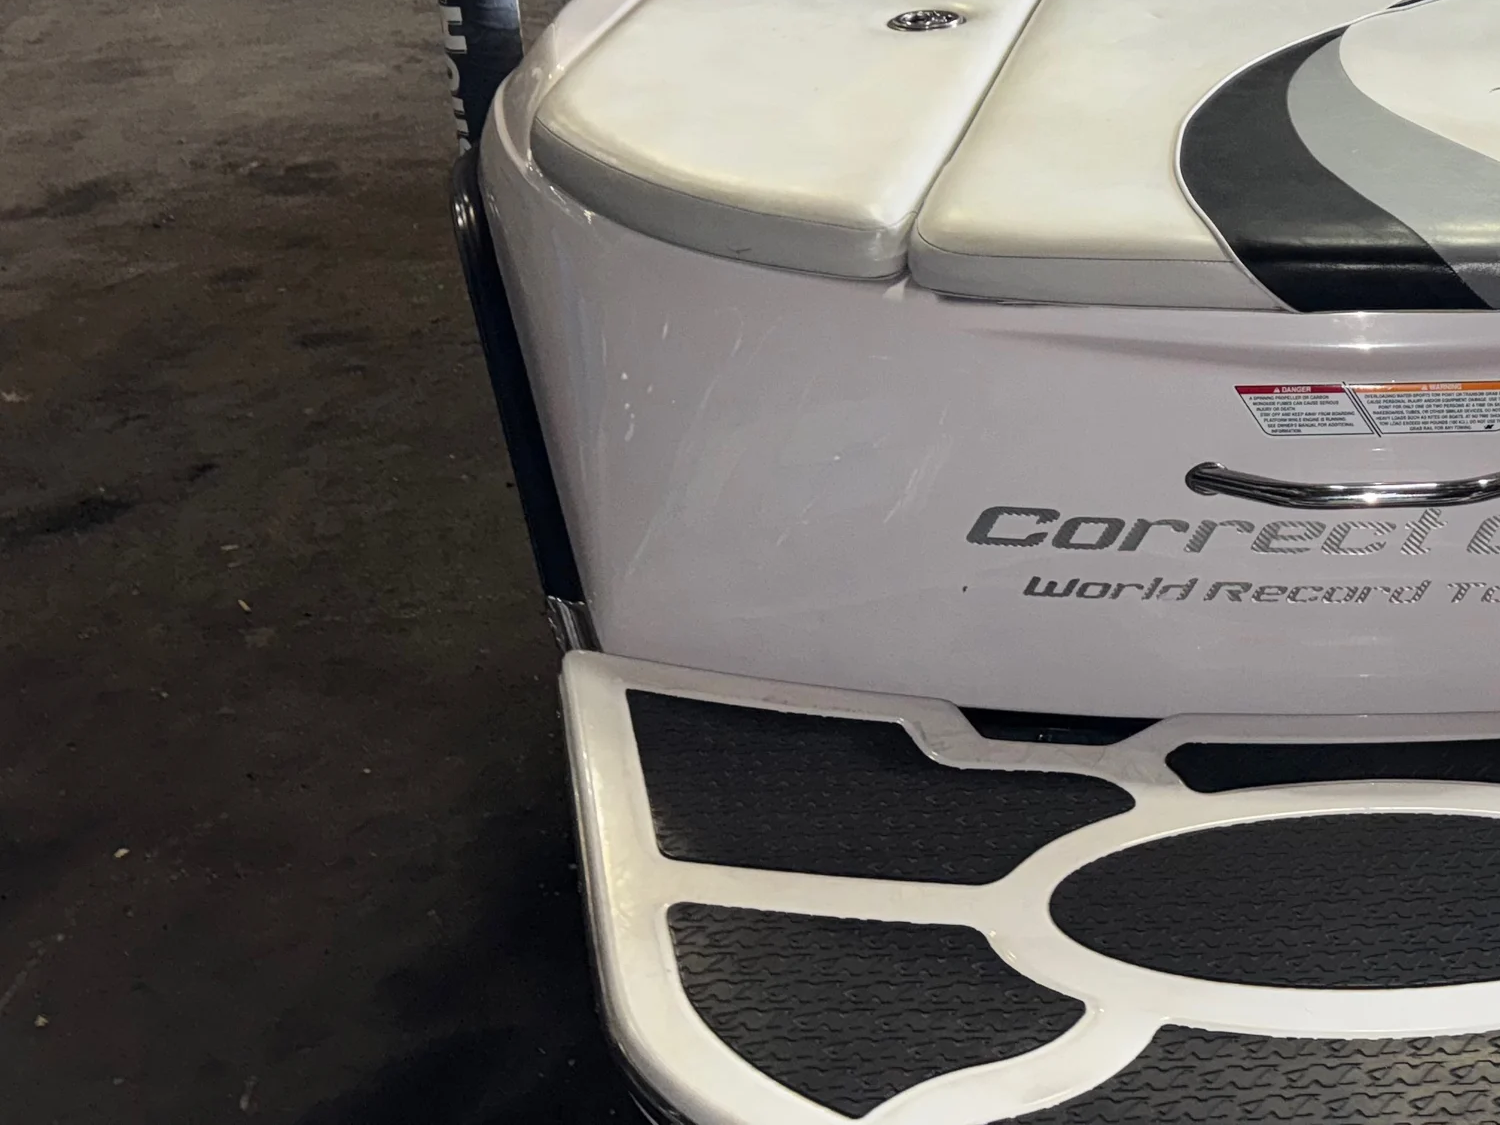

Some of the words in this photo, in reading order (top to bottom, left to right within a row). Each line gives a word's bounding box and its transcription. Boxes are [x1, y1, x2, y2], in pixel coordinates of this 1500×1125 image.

[966, 505, 1448, 556] Correct
[1023, 576, 1199, 601] World
[1203, 579, 1432, 604] Record
